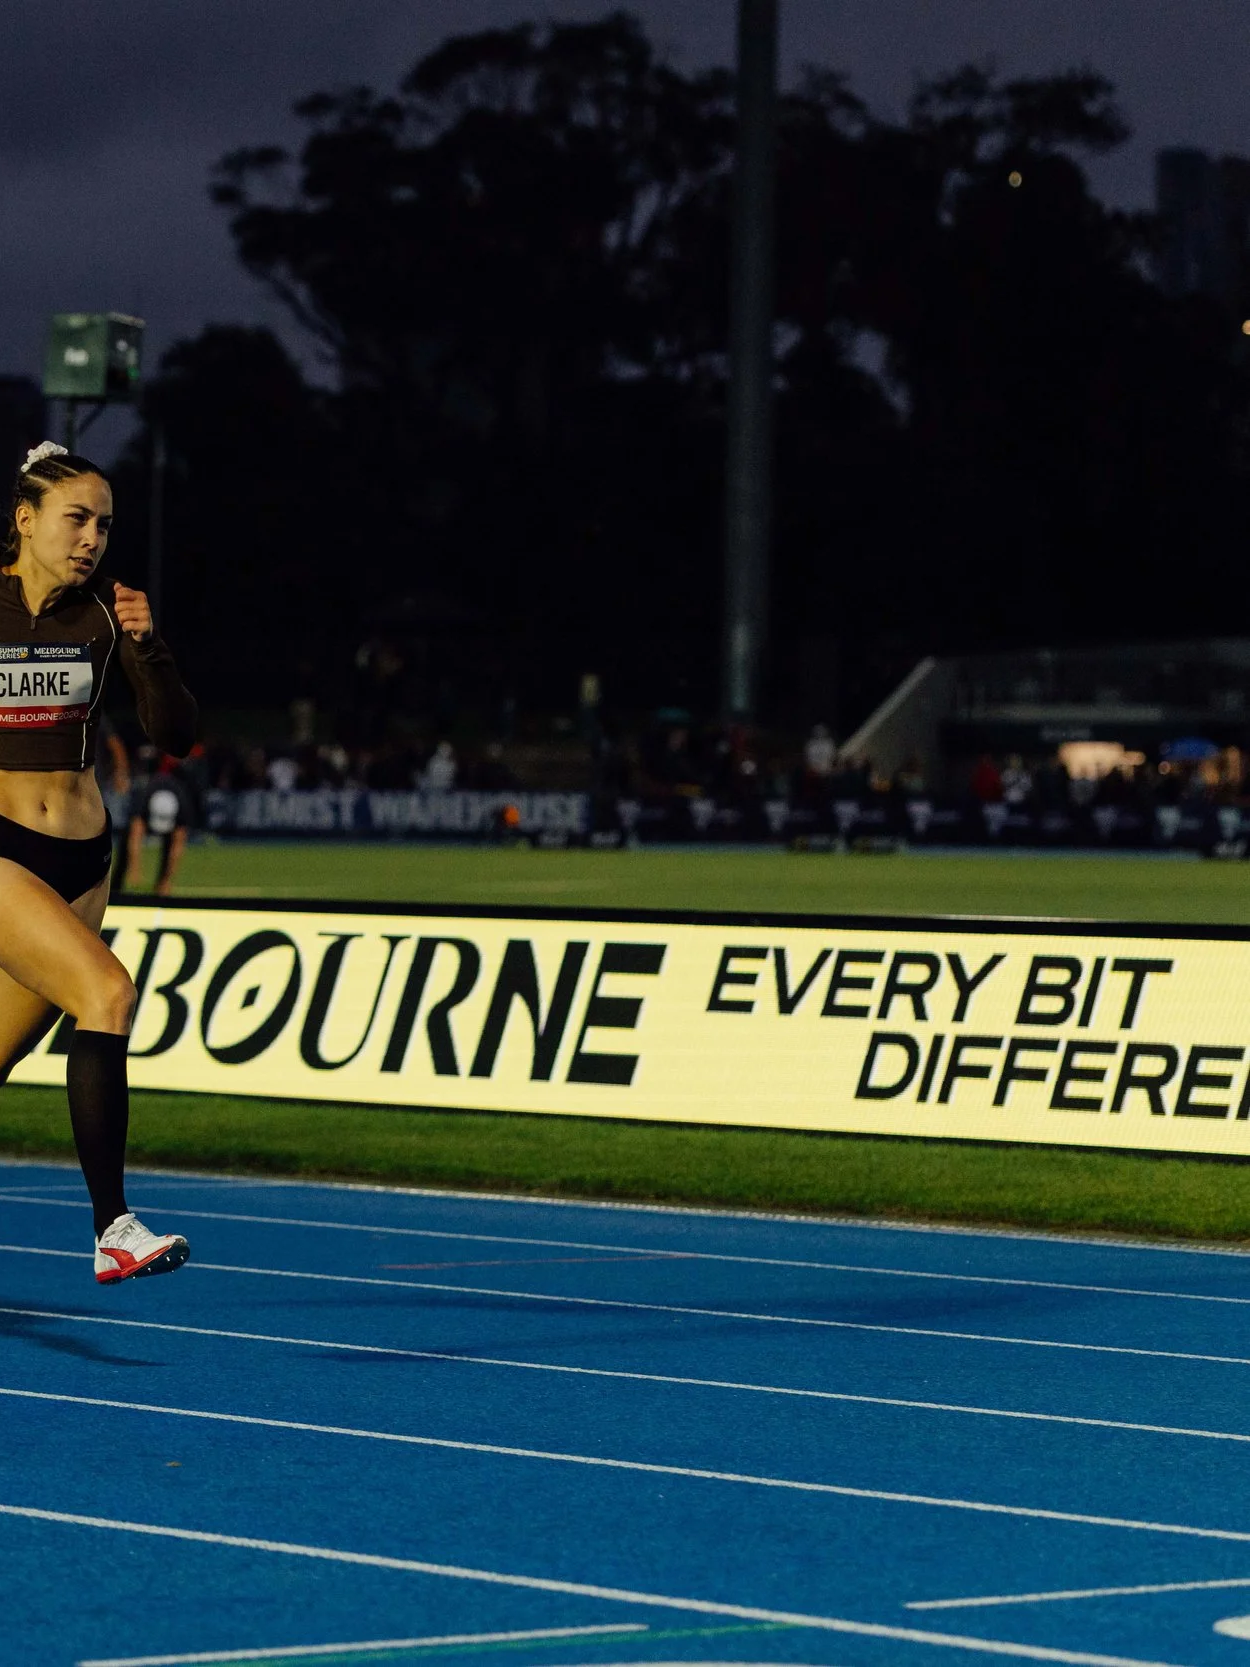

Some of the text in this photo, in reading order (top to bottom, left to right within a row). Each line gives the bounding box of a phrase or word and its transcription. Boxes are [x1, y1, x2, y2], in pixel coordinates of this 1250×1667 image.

[34, 647, 81, 655] MELBOURNE
[370, 789, 588, 831] WAREUSE
[706, 945, 1175, 1030] EVERY BIT
